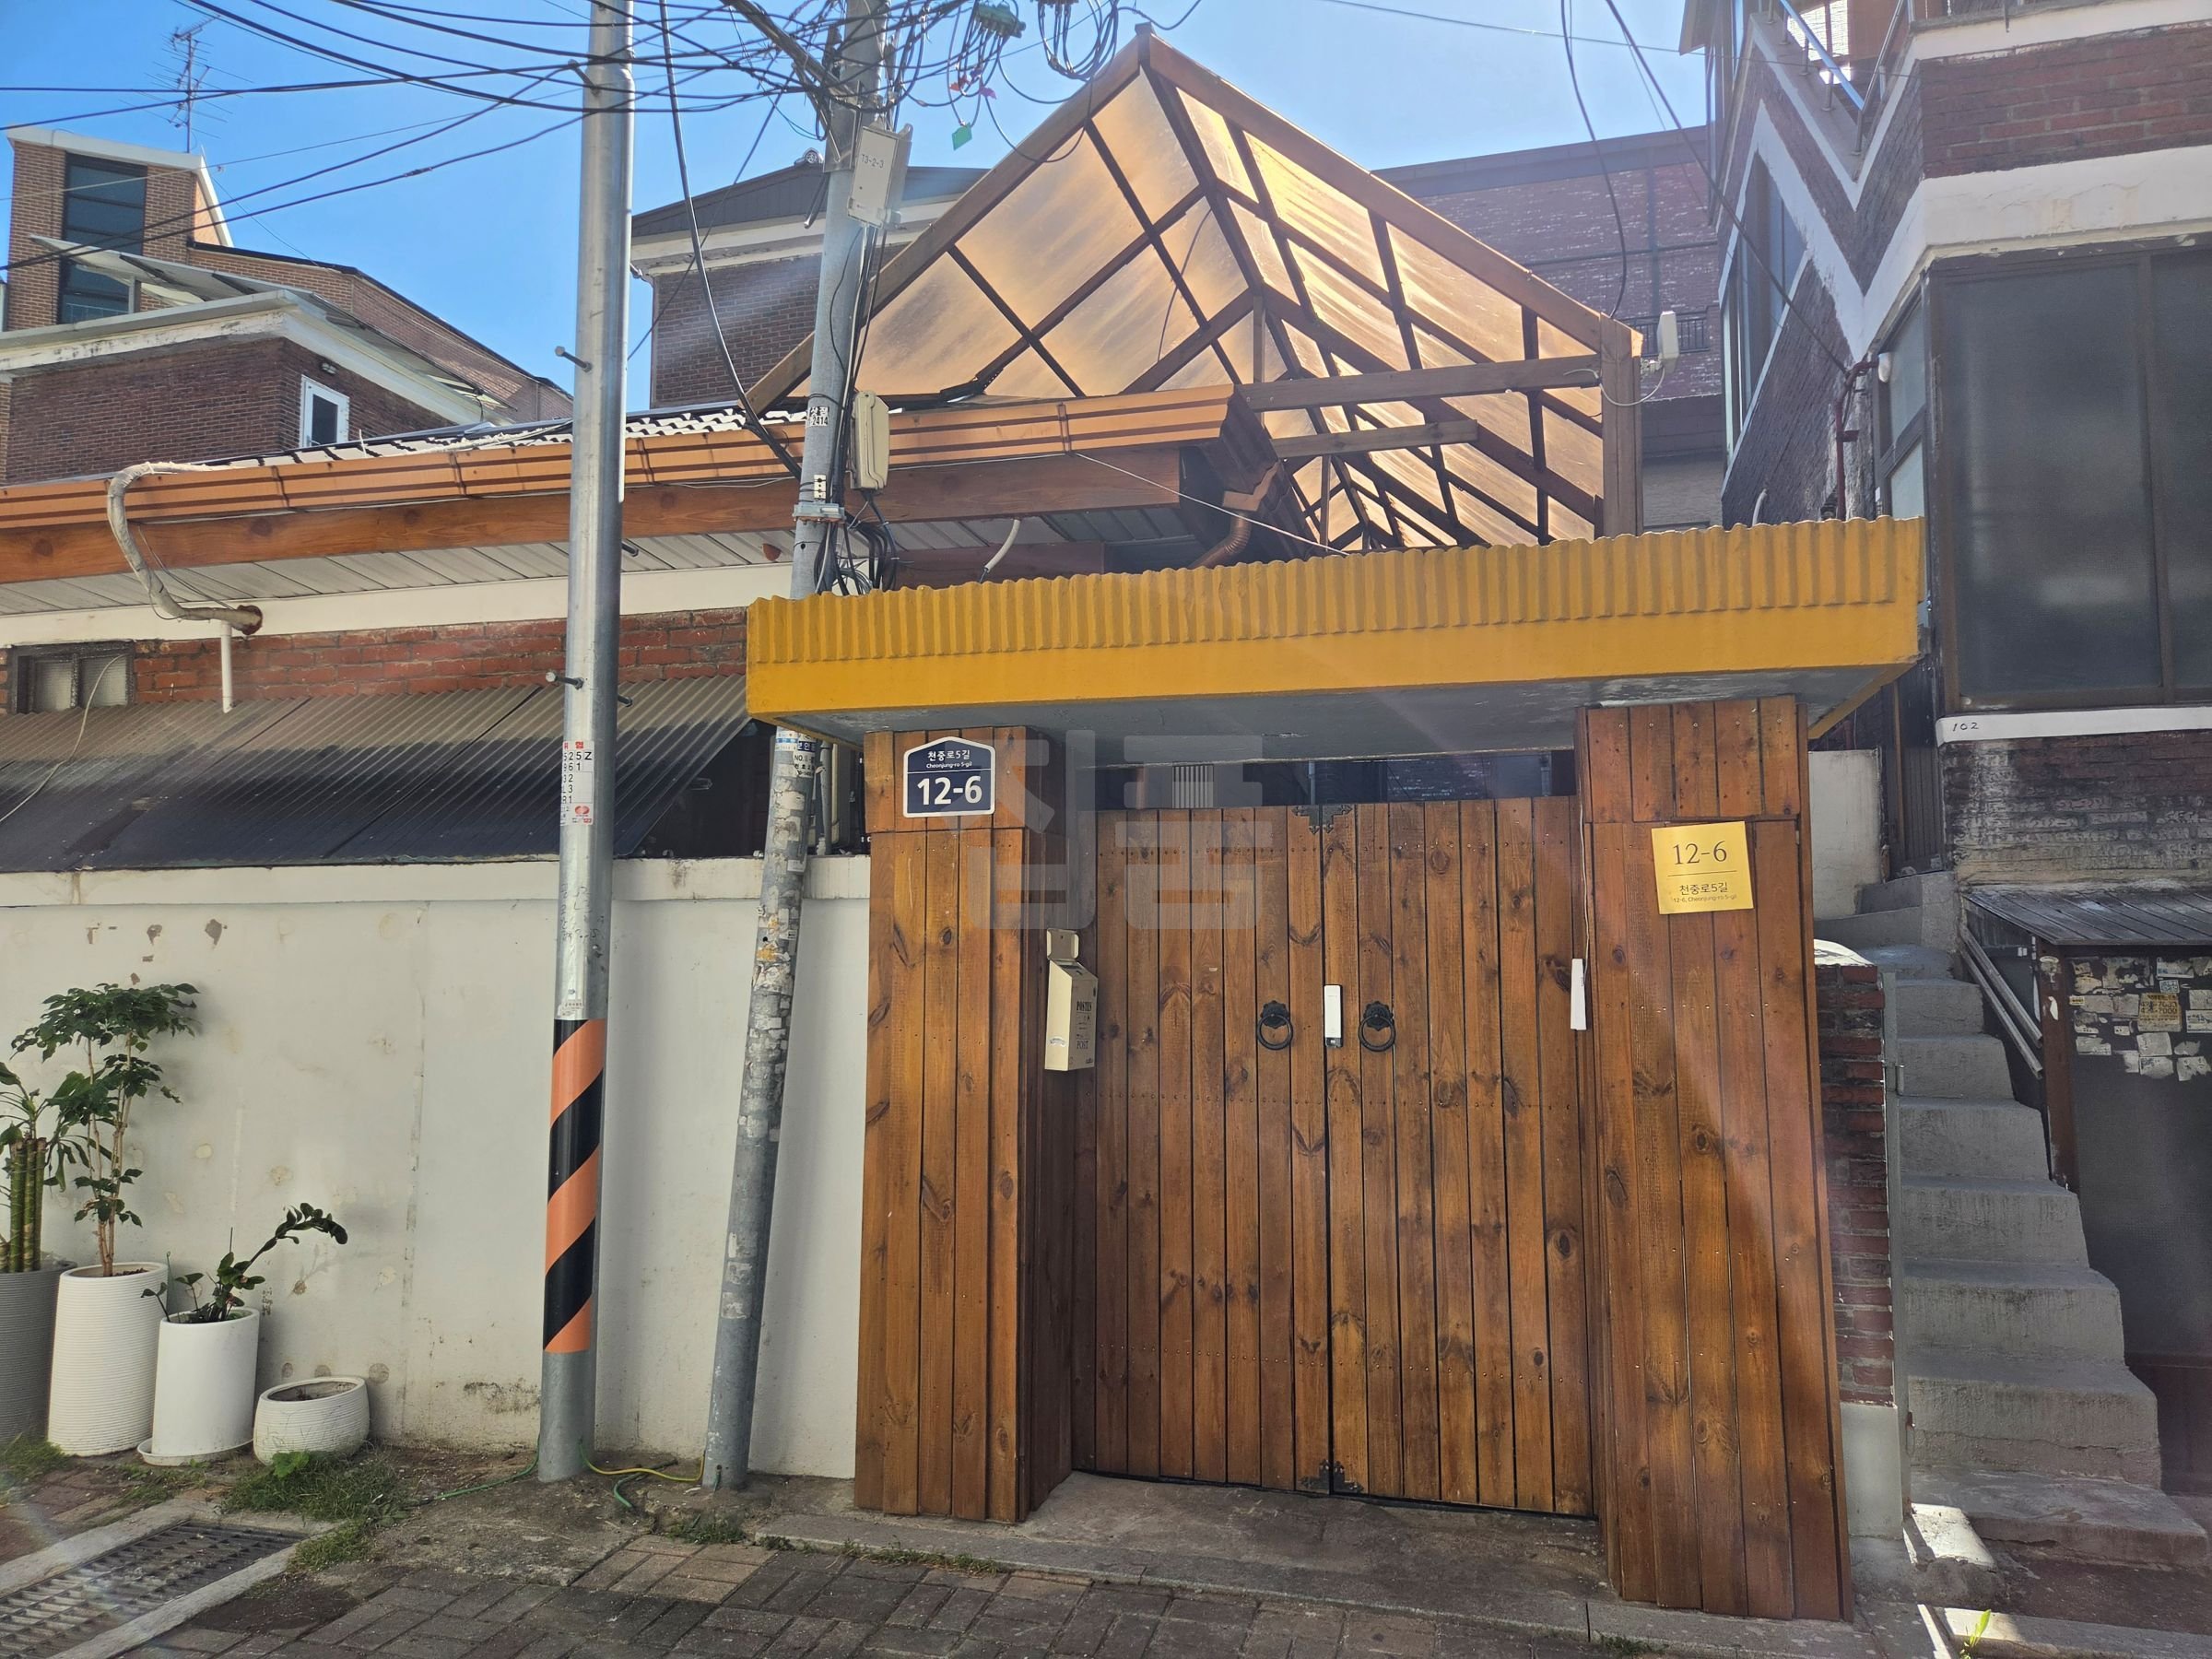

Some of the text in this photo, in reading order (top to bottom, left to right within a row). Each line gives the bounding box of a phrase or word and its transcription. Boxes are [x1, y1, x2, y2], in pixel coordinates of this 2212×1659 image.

[861, 153, 885, 169] T3-2-3
[1952, 722, 1980, 732] 102
[927, 749, 971, 761] 천중로5길
[917, 775, 982, 806] 12-6
[1673, 840, 1727, 865] 12-6
[1679, 882, 1728, 896] 천중로5길
